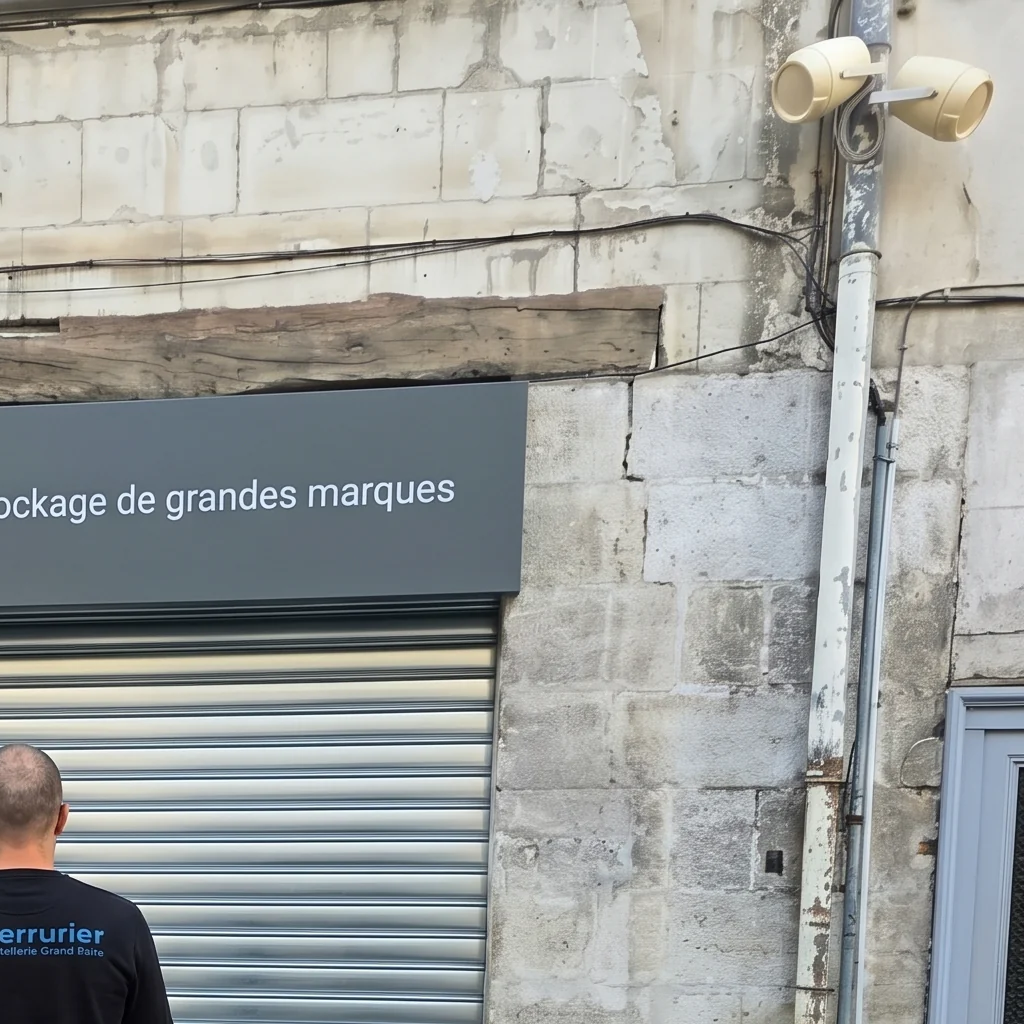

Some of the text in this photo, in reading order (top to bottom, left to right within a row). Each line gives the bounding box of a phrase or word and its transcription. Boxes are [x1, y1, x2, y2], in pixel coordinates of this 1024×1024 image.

[117, 483, 156, 515] de
[165, 478, 297, 521] grandes
[308, 479, 456, 513] marques
[40, 946, 74, 956] Grand
